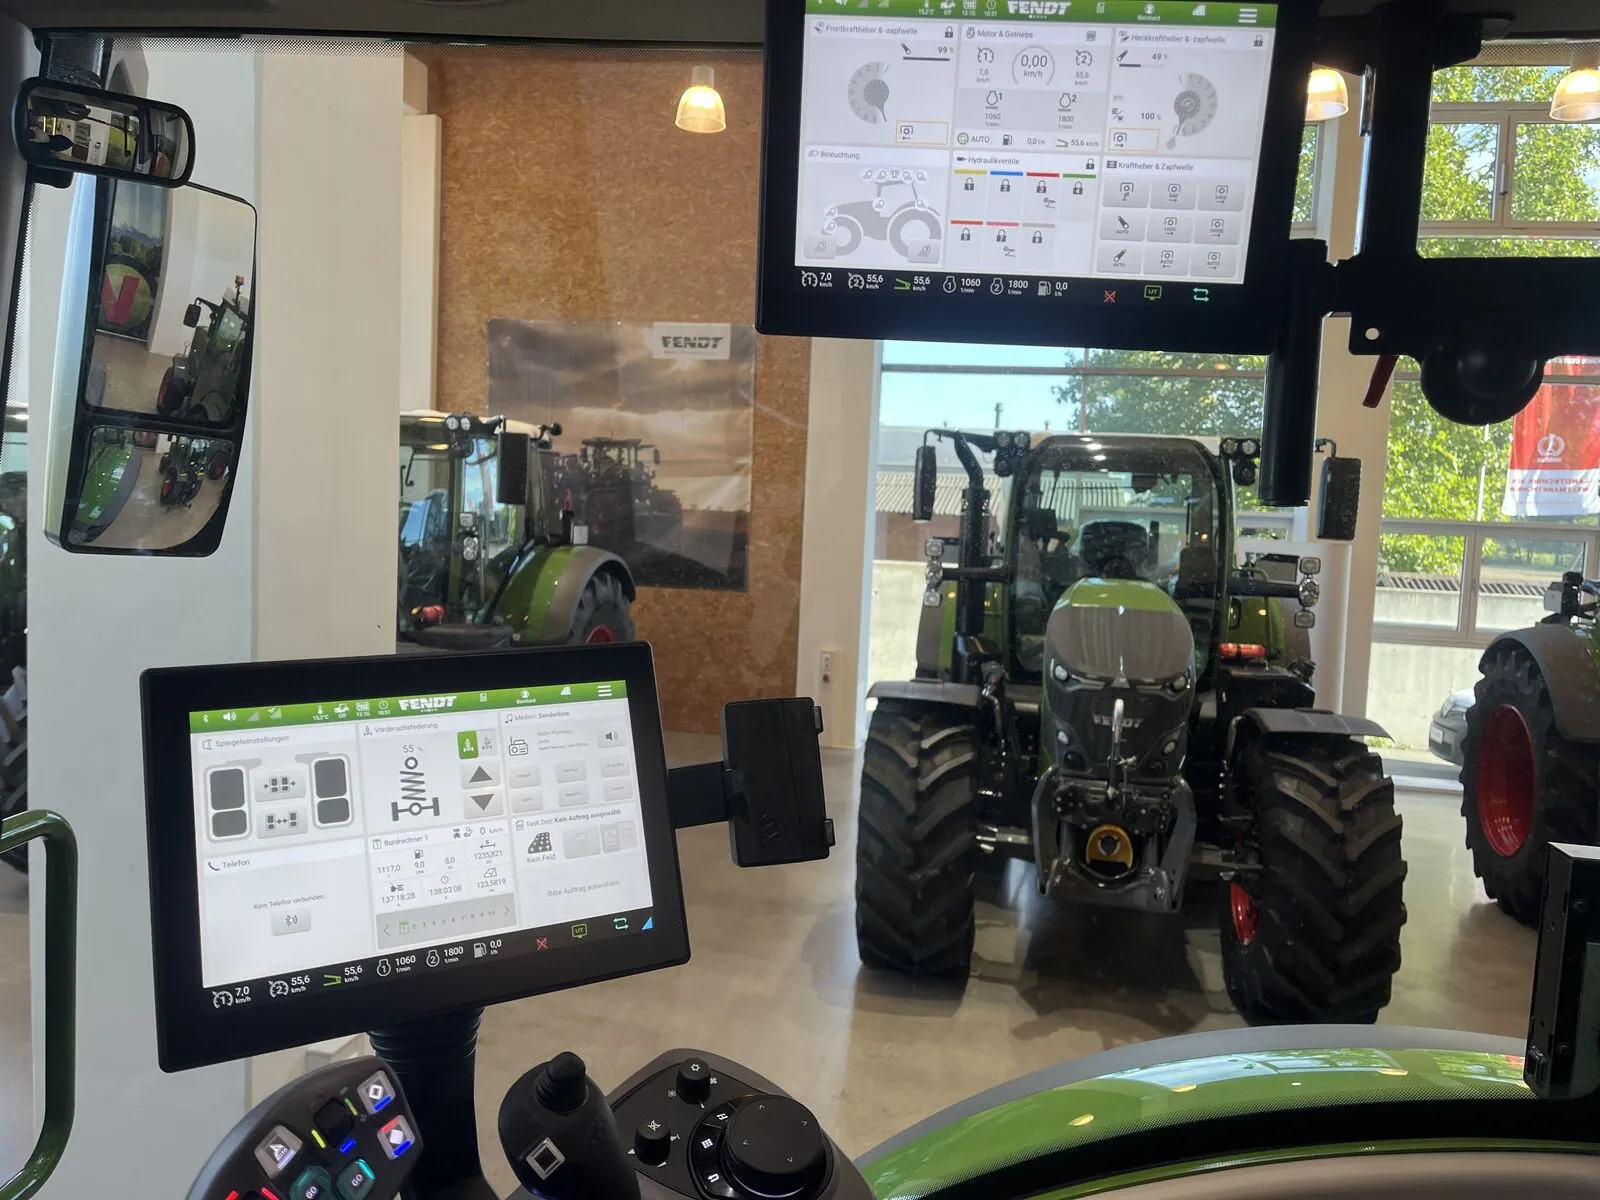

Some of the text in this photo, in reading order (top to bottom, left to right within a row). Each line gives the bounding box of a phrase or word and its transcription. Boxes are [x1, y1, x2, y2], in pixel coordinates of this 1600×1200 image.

[1007, 1, 1071, 15] FENDT
[826, 24, 876, 34] Frontkraftheber
[1005, 31, 1033, 39] Getriebe
[1131, 34, 1182, 43] Heckkraftheber
[1021, 55, 1048, 69] 0,00
[979, 69, 989, 77] 7,0
[1024, 70, 1043, 78] km/h
[1027, 138, 1037, 146] 0,0
[1071, 139, 1085, 147] 55,6
[820, 151, 860, 160] Beleuchtung
[968, 157, 1020, 165] Hydraulikventile
[1118, 162, 1153, 170] Kraftheber
[1161, 164, 1194, 172] Zapfwelle
[820, 272, 832, 281] 7,0
[866, 274, 883, 284] 55,6
[914, 276, 931, 286] 55,6
[961, 278, 981, 287] 1060
[1009, 280, 1028, 289] 1800
[1055, 281, 1068, 291] 0,0
[661, 335, 723, 349] FENDT
[398, 696, 457, 711] FENDT
[538, 710, 570, 719] Senderliste
[1093, 714, 1144, 728] FEDT
[374, 722, 438, 734] Vorderachsfederung
[215, 735, 290, 748] Spiegeleinstellungen
[402, 744, 414, 753] 55
[526, 820, 540, 828] Task
[554, 816, 568, 825] Kein
[568, 812, 590, 823] Auftrag
[384, 836, 423, 847] Bordrechner
[474, 850, 503, 860] 1235,821
[527, 854, 556, 864] Kein Feld
[222, 859, 251, 869] Telefon
[377, 864, 401, 874] 1117,0
[414, 860, 425, 869] 9,0
[548, 890, 562, 898] Bitte
[564, 885, 587, 895] Auftrag
[381, 892, 416, 904] 137:18:28
[253, 901, 268, 910] Kein
[269, 898, 292, 908] Telefon
[490, 939, 502, 949] 0,0
[443, 946, 464, 957] 1800
[395, 955, 416, 966] 1060
[344, 965, 363, 976] 55,6
[291, 975, 310, 986] 55,6
[235, 986, 249, 997] 7,0
[352, 1174, 363, 1187] GO
[305, 1186, 317, 1199] GO
